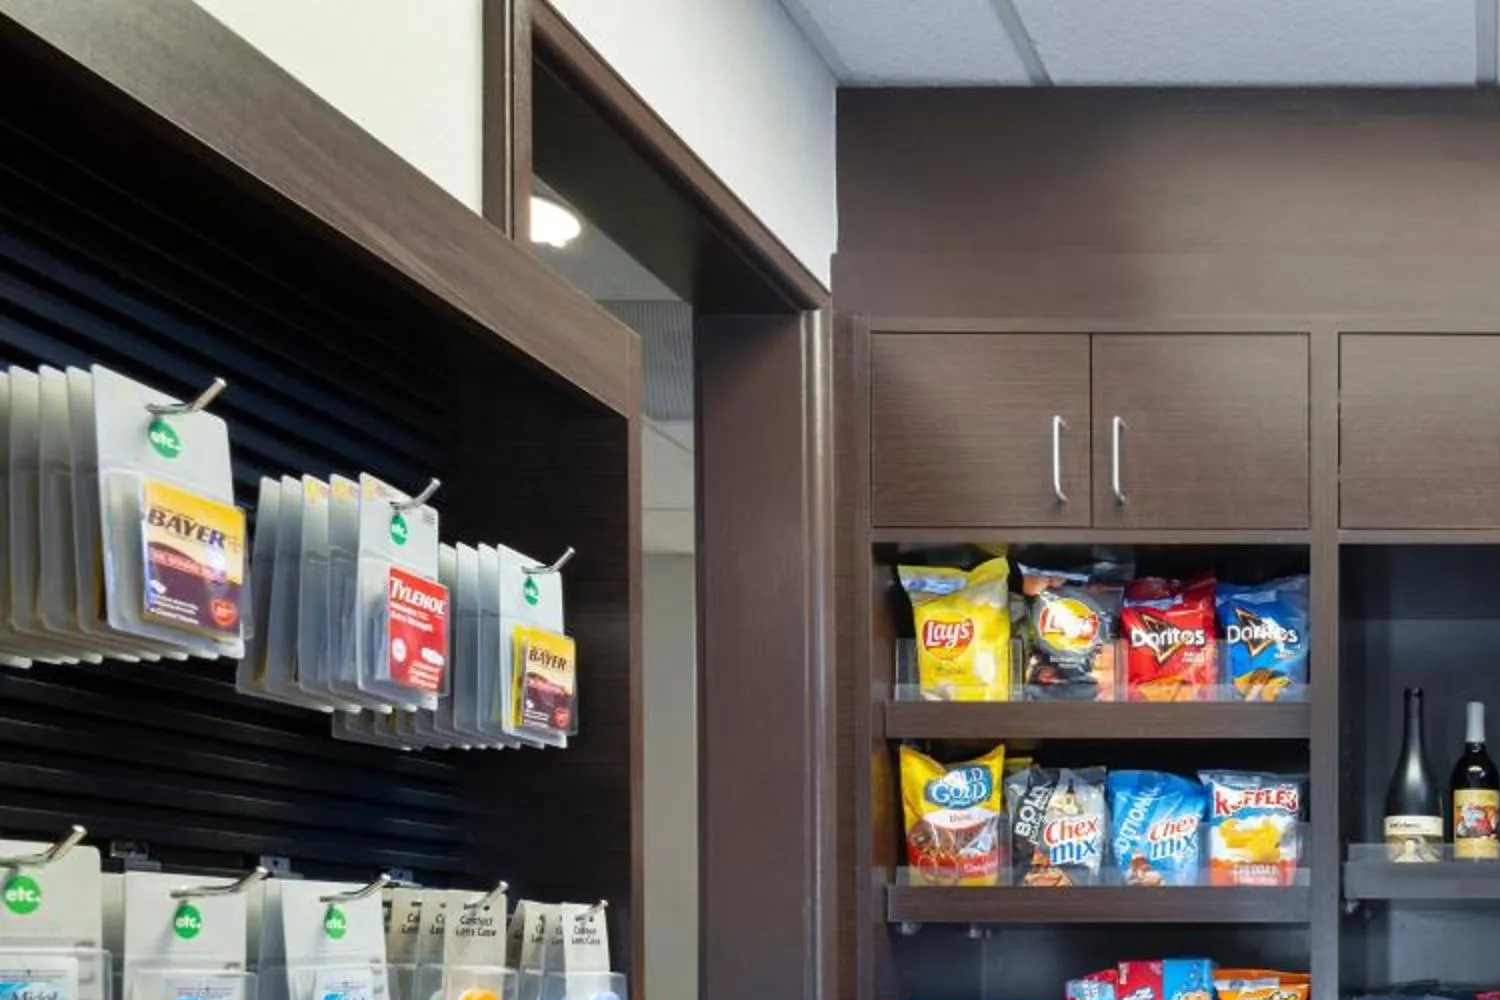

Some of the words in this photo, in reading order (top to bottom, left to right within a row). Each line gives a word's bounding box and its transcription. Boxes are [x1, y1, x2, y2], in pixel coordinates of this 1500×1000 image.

[149, 509, 226, 549] BAYER
[391, 577, 446, 615] TYLENOL
[926, 619, 971, 649] Lay's
[1131, 626, 1205, 648] Doritos
[1227, 625, 1299, 644] Doritos
[528, 646, 567, 671] BAYER
[930, 783, 987, 803] GOLD
[1043, 815, 1099, 845] Chex
[1149, 813, 1200, 842] Chex
[1049, 839, 1097, 865] mix
[5, 887, 41, 902] etc.
[175, 915, 201, 929] etc.
